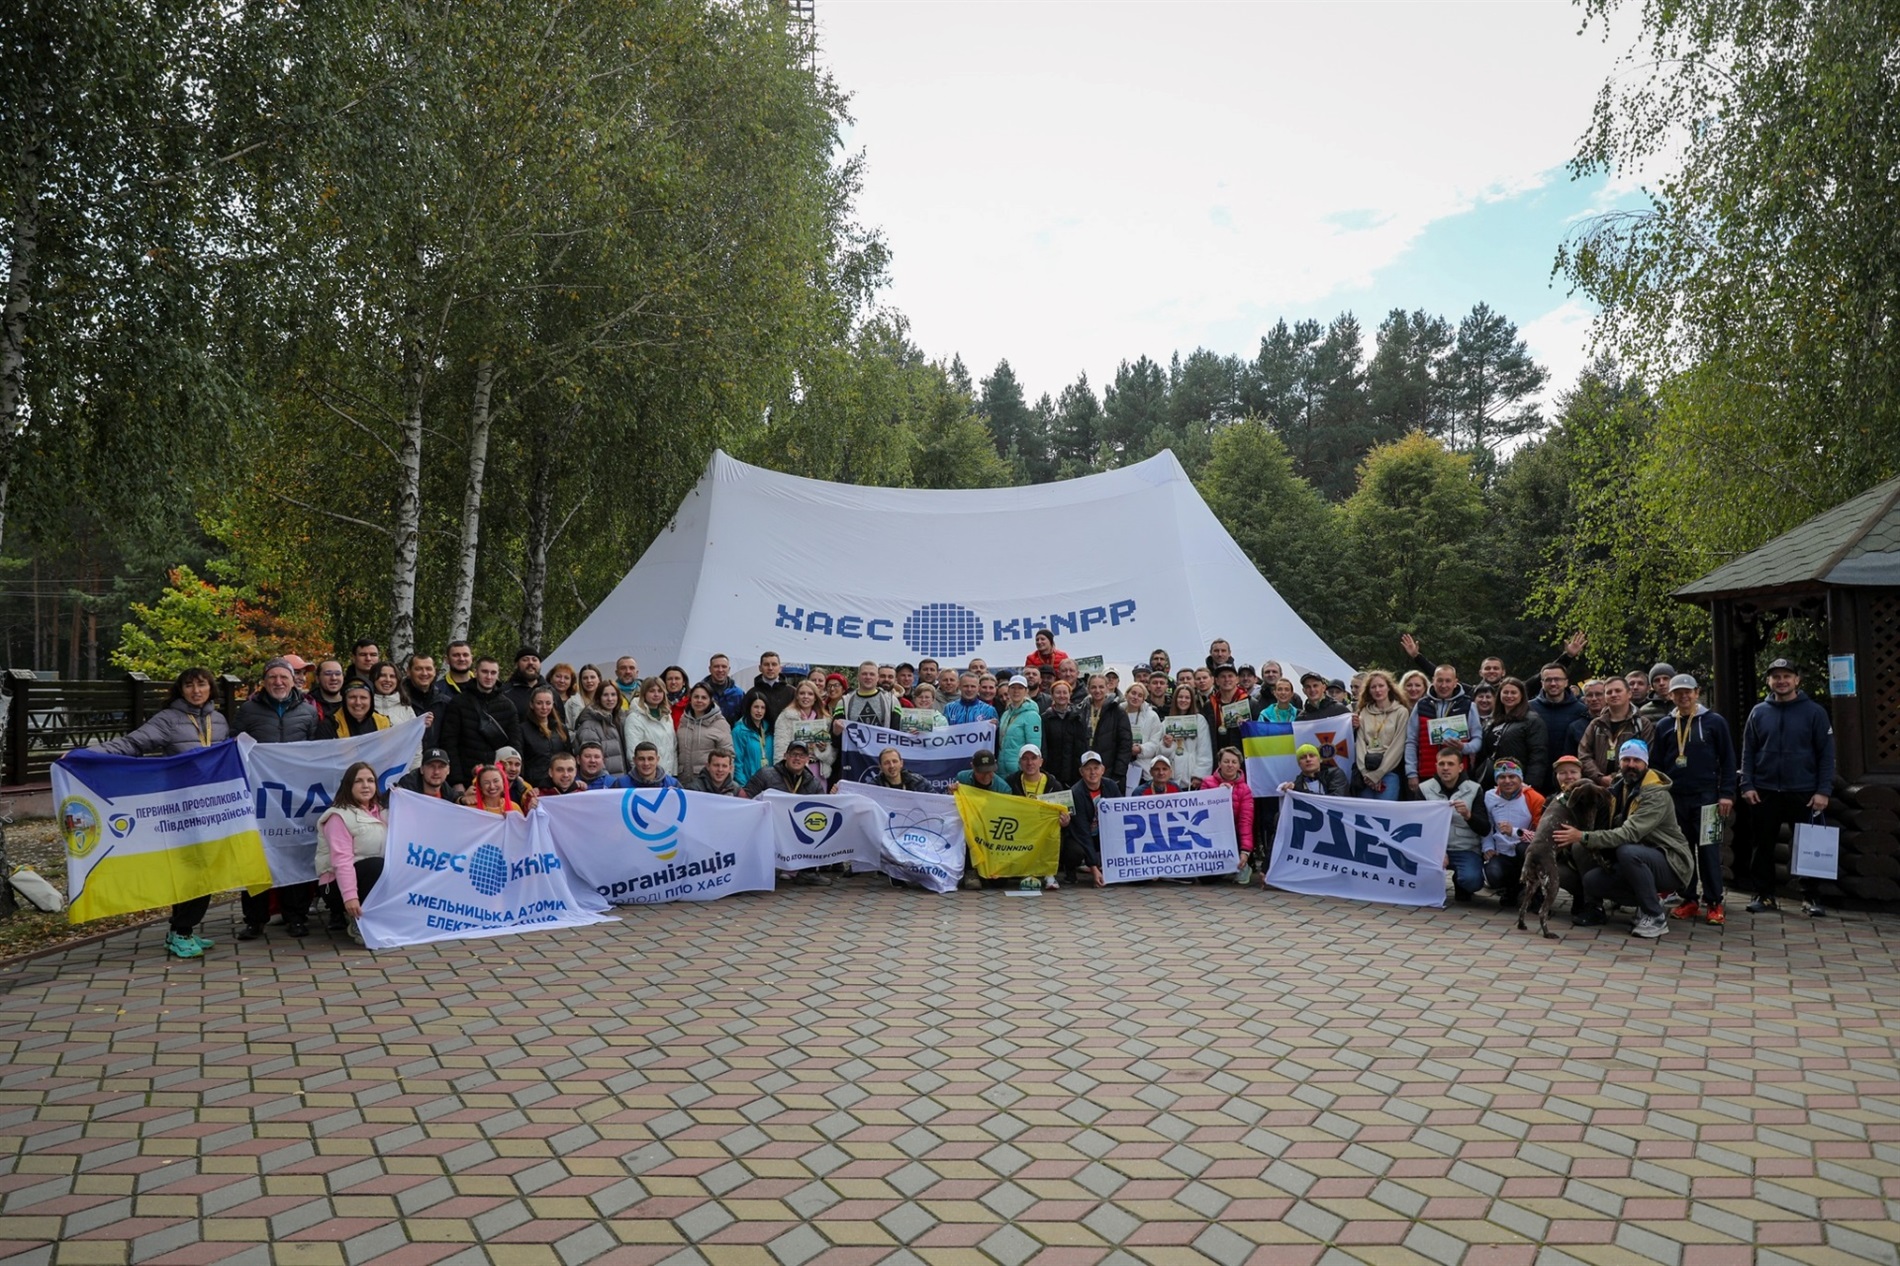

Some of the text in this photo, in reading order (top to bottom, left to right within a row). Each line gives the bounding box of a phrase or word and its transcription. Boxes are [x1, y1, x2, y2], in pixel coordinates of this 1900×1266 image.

[876, 730, 992, 748] ЕНЕРГОАТОМ
[136, 802, 181, 819] ПЕРВИННА
[1114, 797, 1198, 813] ENERGOATOM
[995, 844, 1034, 852] RUNNING
[1106, 849, 1235, 868] РІВНЕНСЬКА АТОМНА
[1118, 860, 1225, 878] ЕЛЕКТРОСТАНЦІЯ
[1286, 854, 1417, 889] РІВНЕНСЬКА АЕС
[665, 884, 693, 899] ППО
[697, 873, 732, 892] ХАЕС
[407, 892, 514, 922] ХМЕЛЬНИЦЬКА
